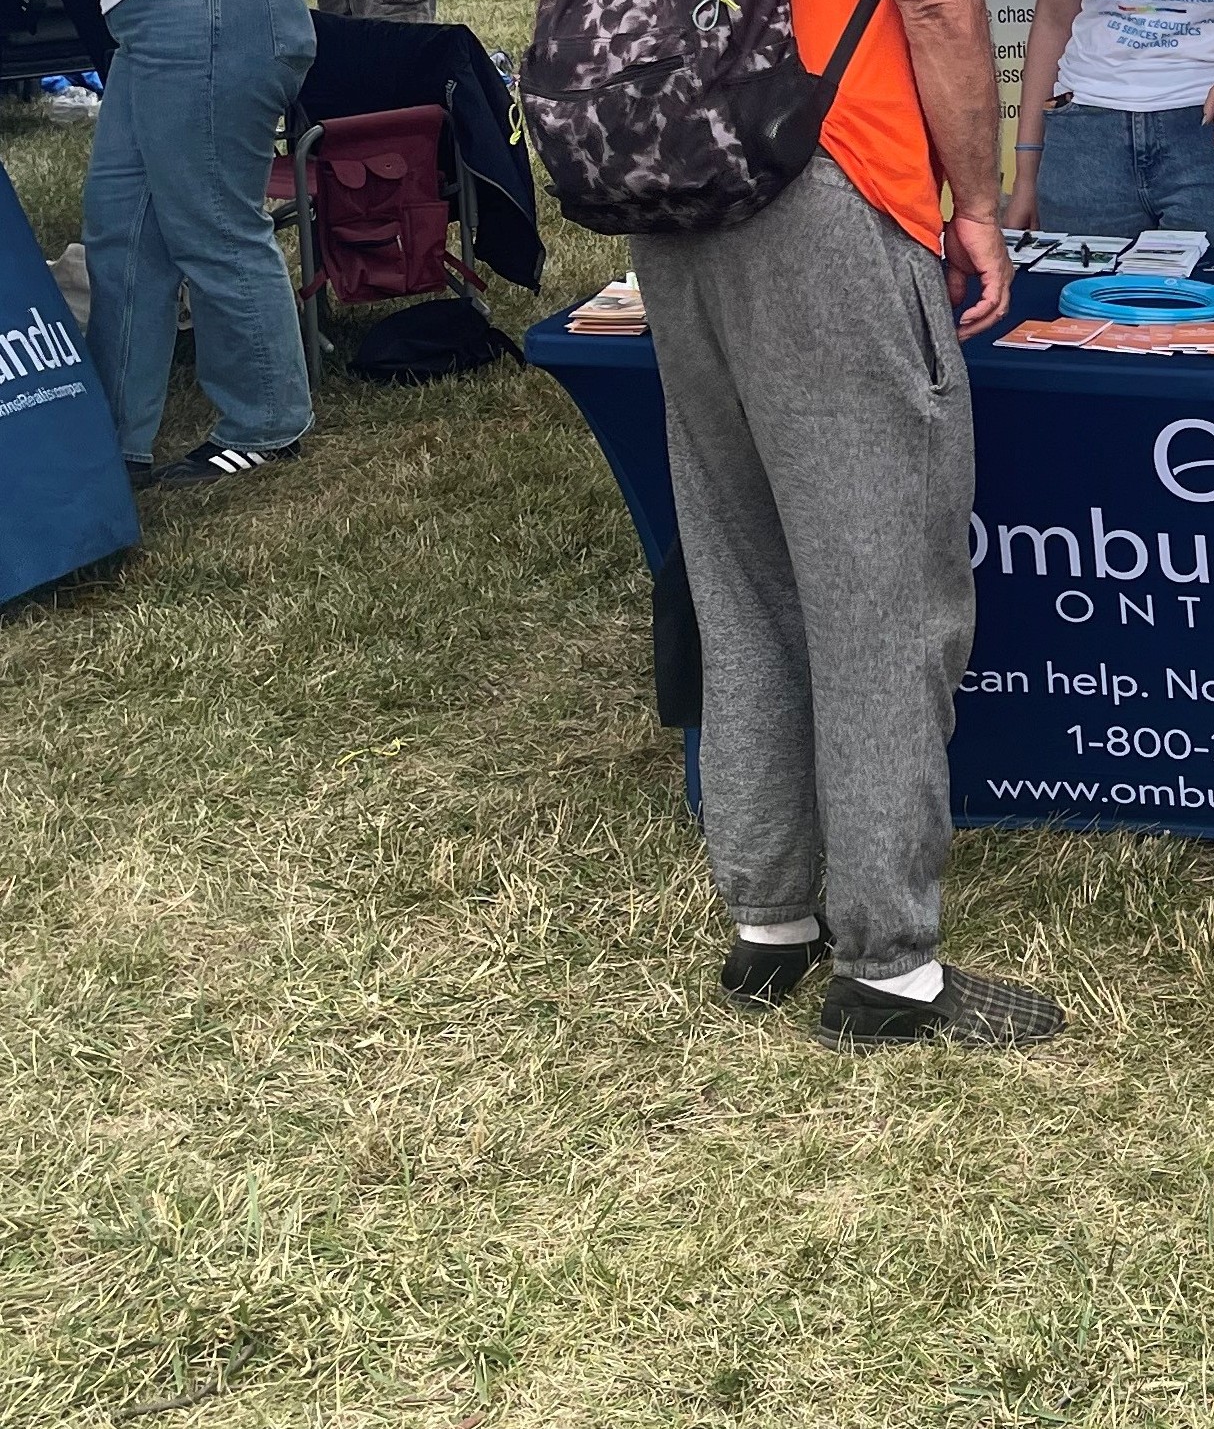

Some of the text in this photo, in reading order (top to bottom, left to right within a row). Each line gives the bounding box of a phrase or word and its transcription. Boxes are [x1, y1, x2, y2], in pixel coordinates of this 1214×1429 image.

[1107, 20, 1122, 31] LES
[958, 670, 1029, 693] can
[1046, 661, 1150, 706] help.
